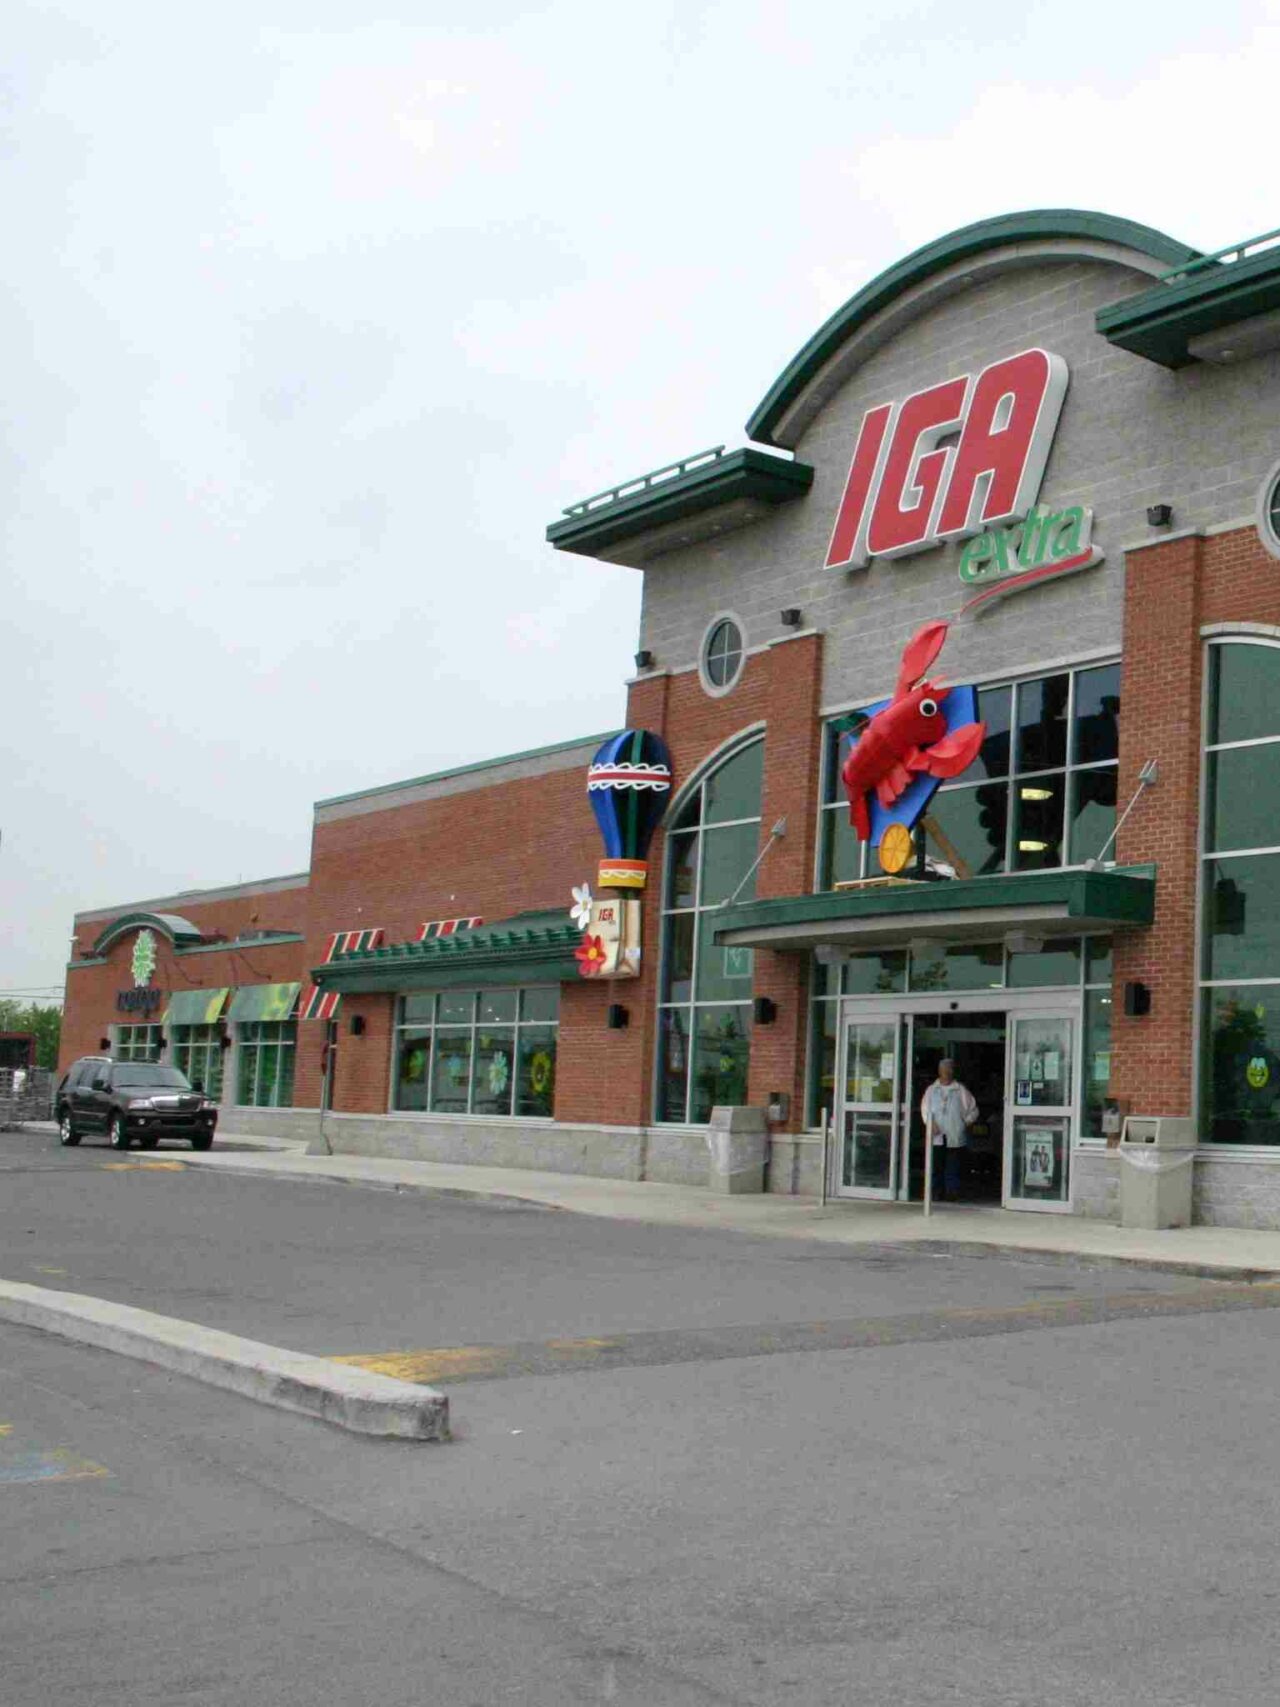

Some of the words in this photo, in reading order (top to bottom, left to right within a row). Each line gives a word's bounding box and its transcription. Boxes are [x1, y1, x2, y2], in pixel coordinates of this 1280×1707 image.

[823, 348, 1068, 571] IGA
[958, 506, 1093, 583] extra
[598, 907, 614, 921] IGA
